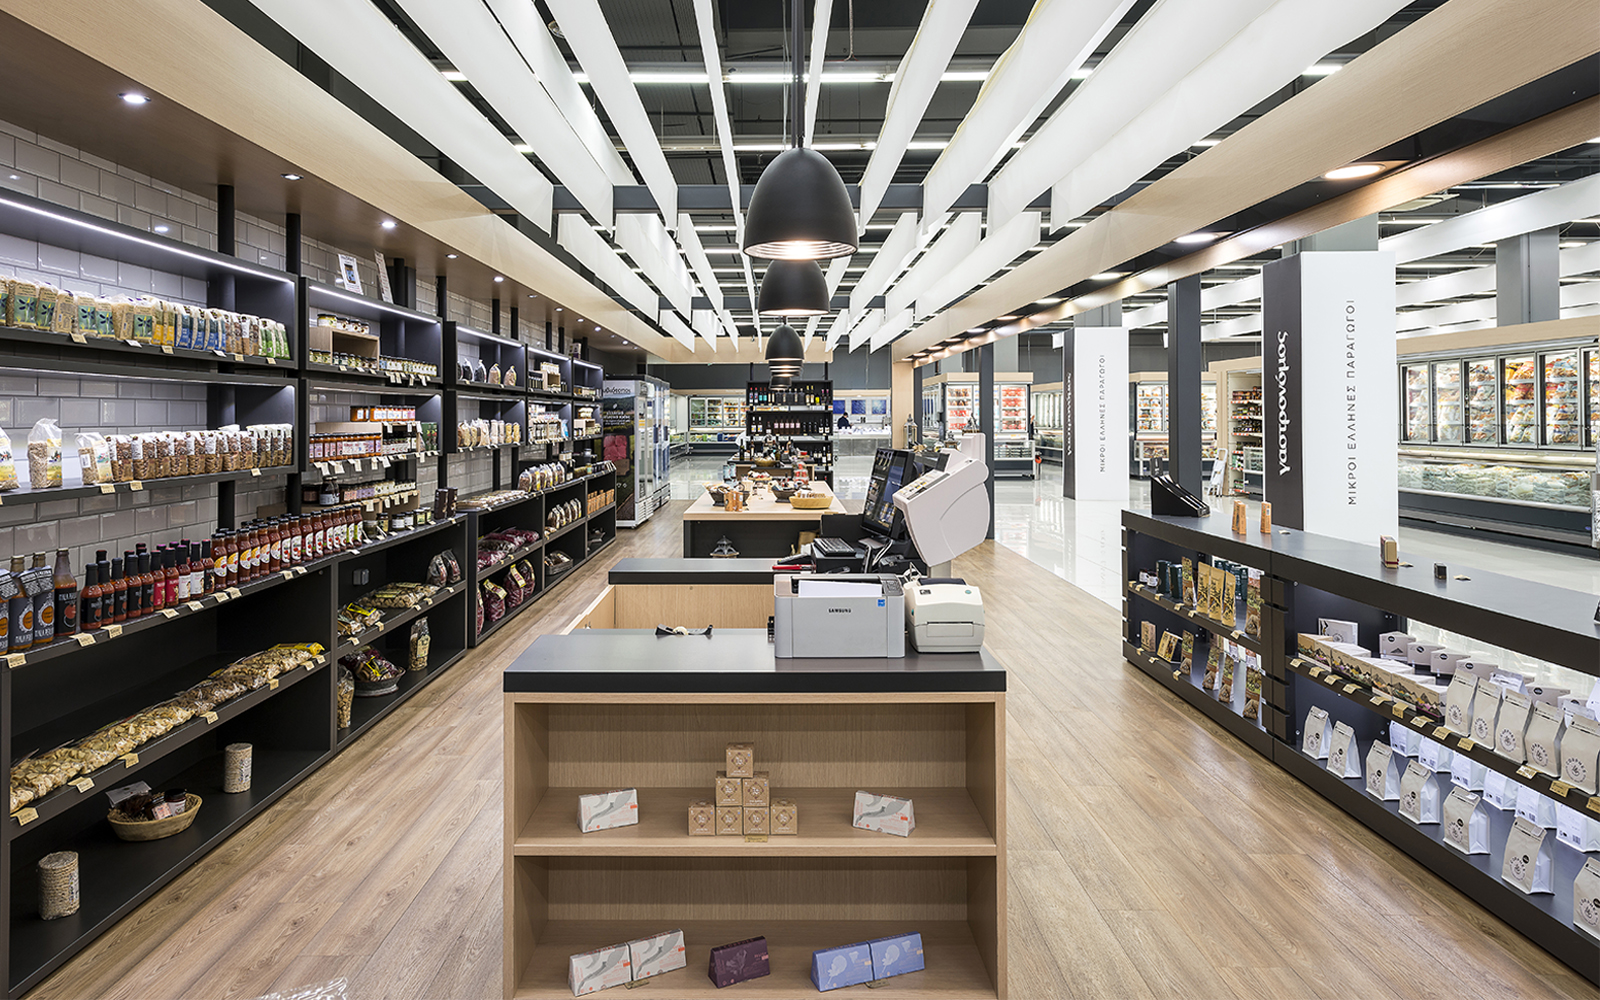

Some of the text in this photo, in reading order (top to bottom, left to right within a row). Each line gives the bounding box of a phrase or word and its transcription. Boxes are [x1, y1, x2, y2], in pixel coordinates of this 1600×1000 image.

[1098, 354, 1106, 401] ΠΑΡΑΓΩΓΟΙ
[1274, 330, 1291, 476] γαστρονόμος
[1345, 300, 1357, 506] ΜΙΚΡΟΙ ΕΛΛΗΝΕΣ ΠΑΡΑΓΩΓΟΙ
